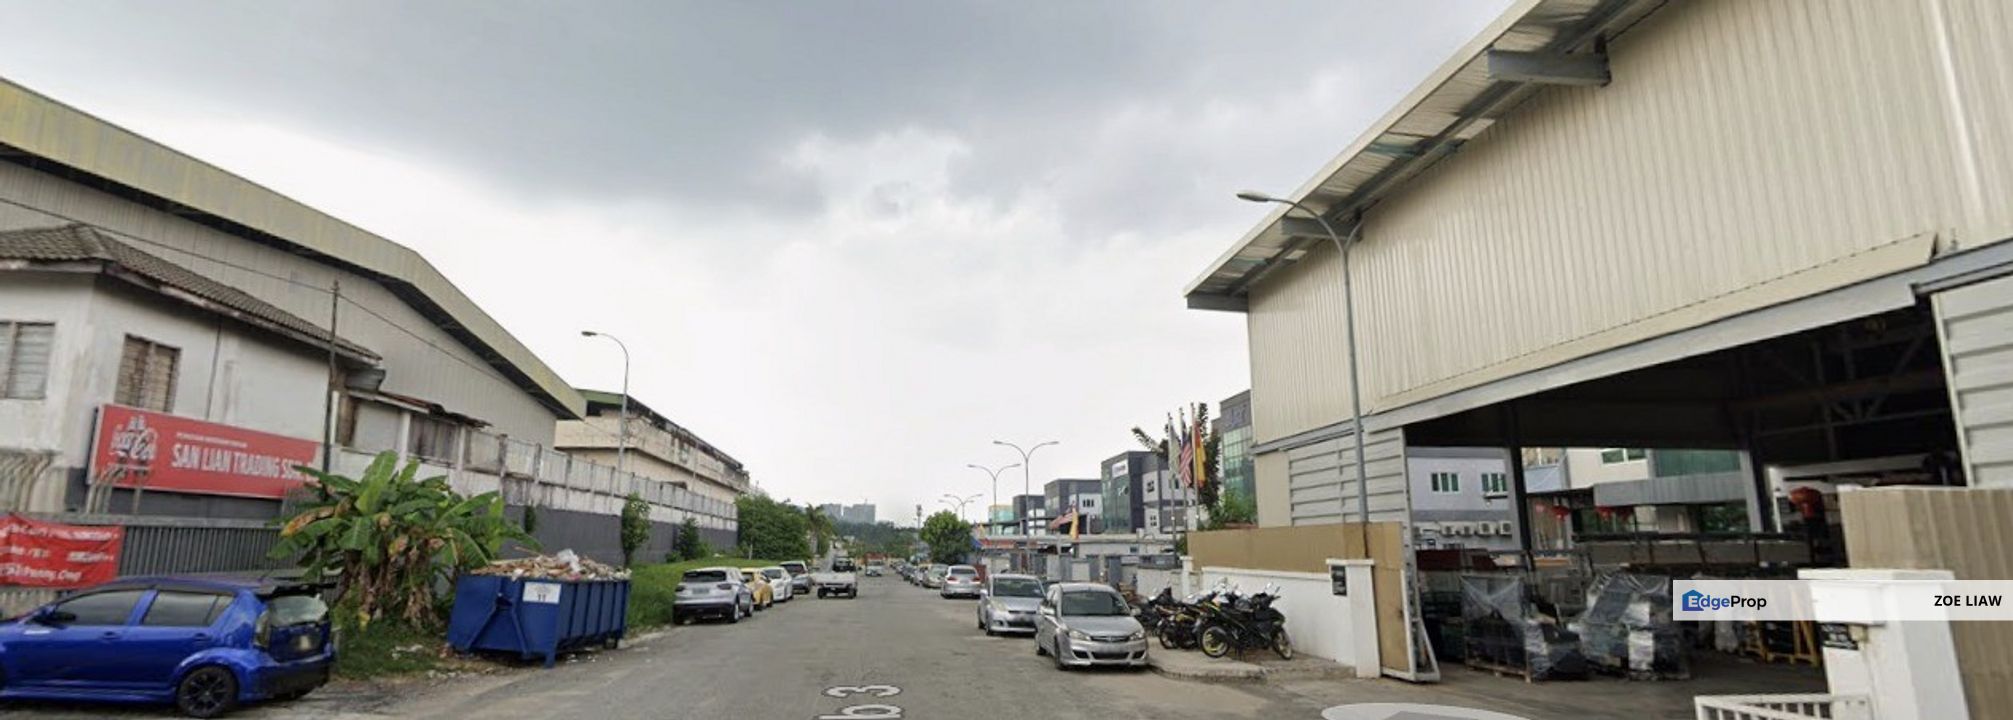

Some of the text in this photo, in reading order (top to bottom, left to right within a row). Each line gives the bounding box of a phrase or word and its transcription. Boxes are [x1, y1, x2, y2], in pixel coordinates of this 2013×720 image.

[172, 443, 200, 468] SAN
[201, 448, 231, 472] LIAN
[232, 452, 280, 478] TRADING
